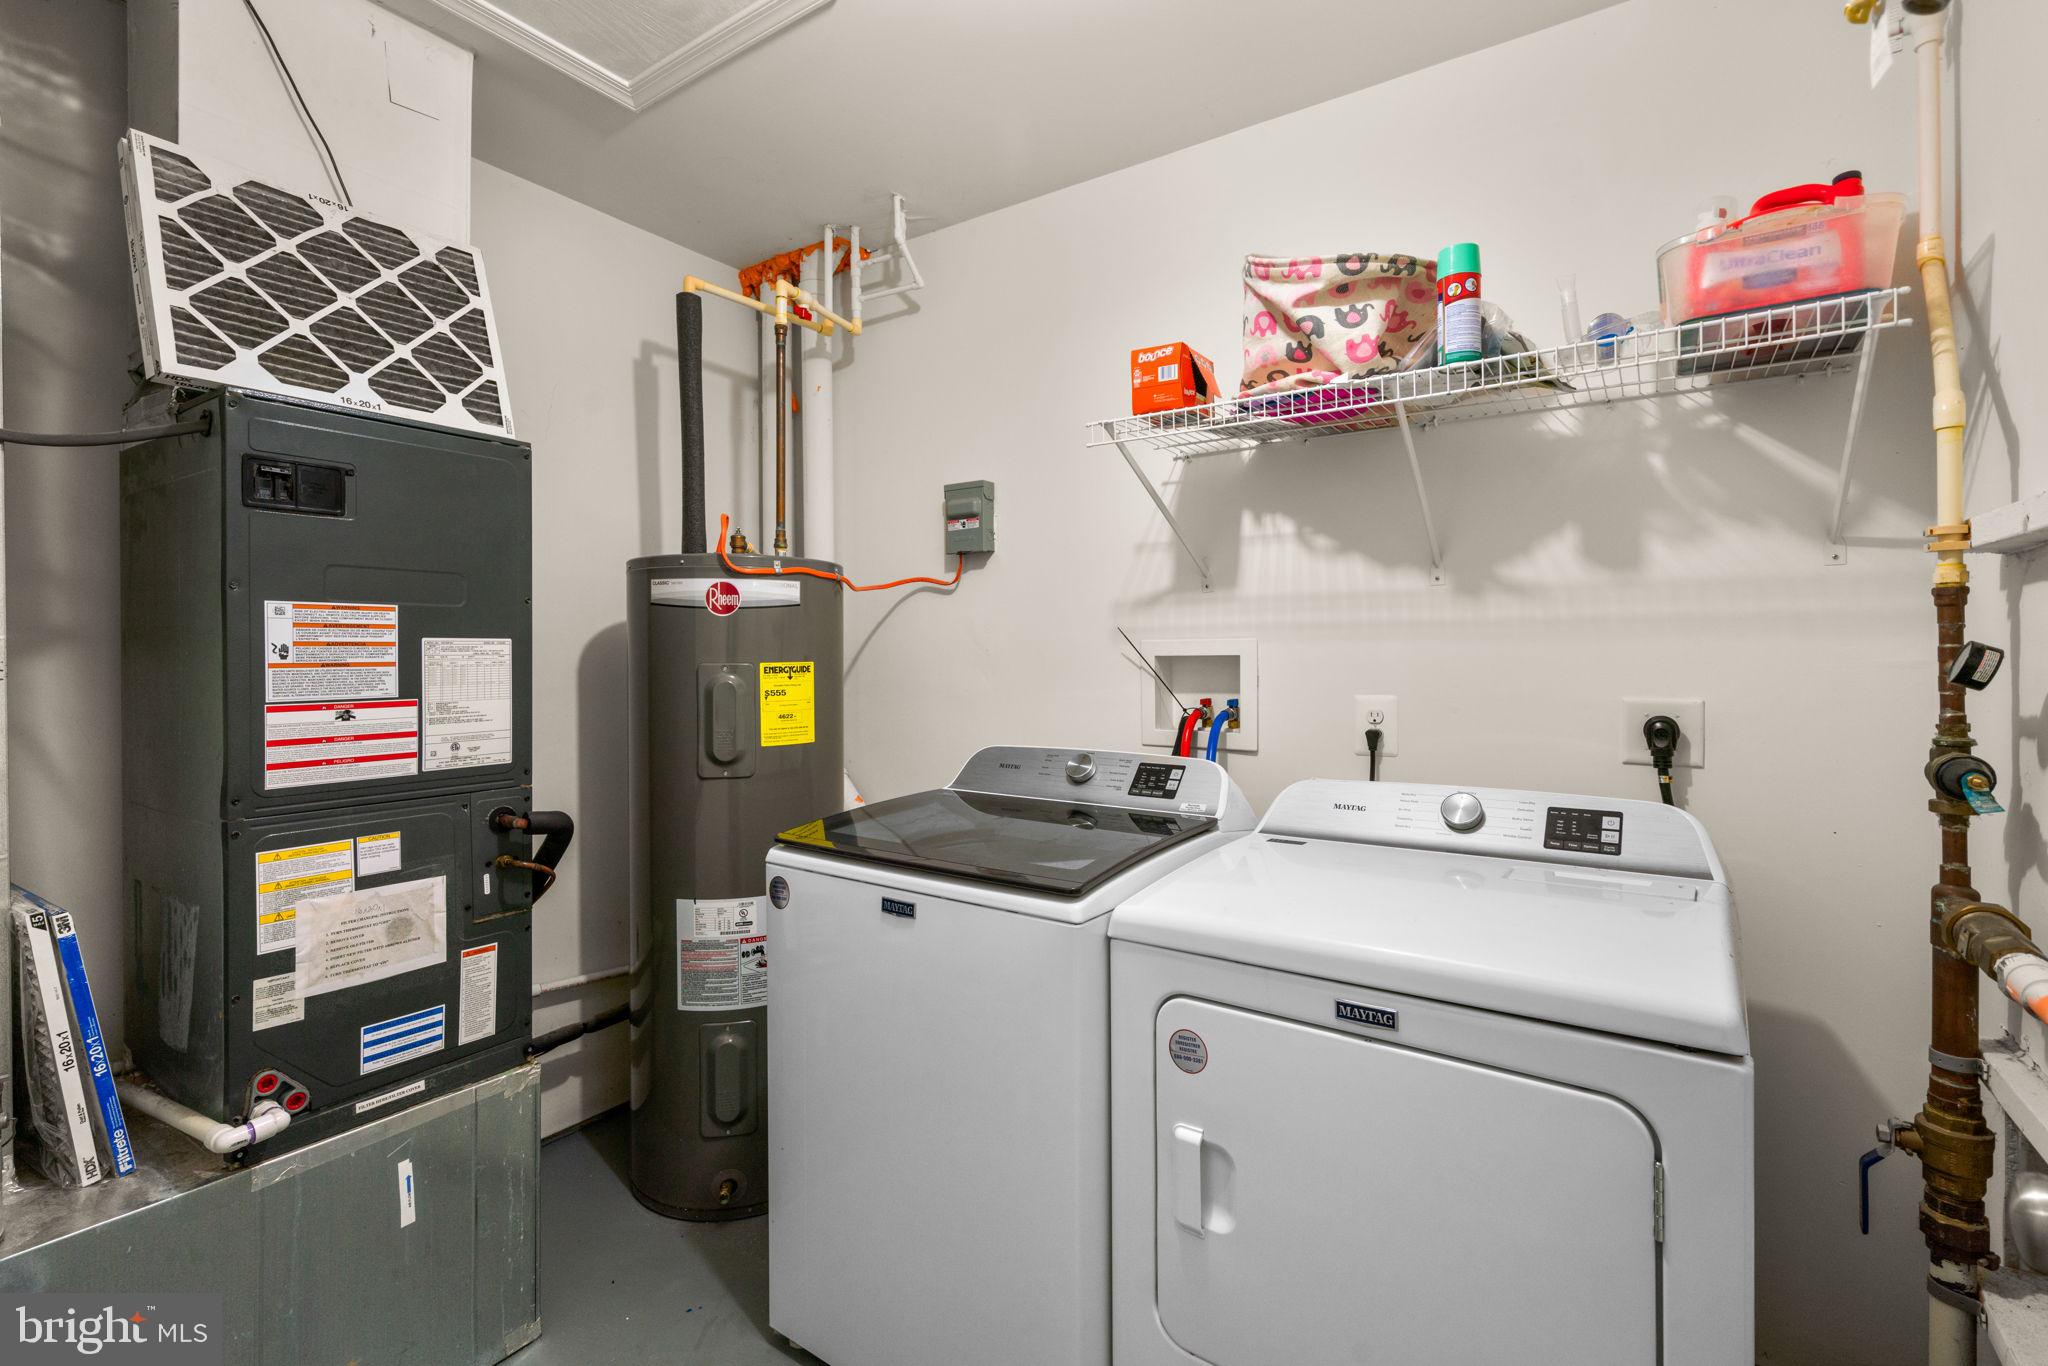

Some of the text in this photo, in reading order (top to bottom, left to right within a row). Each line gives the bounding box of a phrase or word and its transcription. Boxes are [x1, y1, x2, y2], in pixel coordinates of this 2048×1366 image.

[1138, 346, 1174, 363] bounce
[340, 396, 382, 410] 16x20x1
[708, 578, 738, 610] Rheem
[764, 666, 811, 675] ENERGYGUIDE
[1333, 803, 1367, 812] MAYTAG
[883, 901, 913, 915] MAYTAG
[55, 914, 71, 934] 3M
[1338, 1004, 1394, 1026] MAYTAG
[56, 1031, 75, 1072] 16x20x1
[86, 1036, 107, 1077] 16x20x1
[406, 1085, 421, 1093] COVER
[114, 1128, 132, 1172] Filtrete
[84, 1156, 98, 1180] HDX
